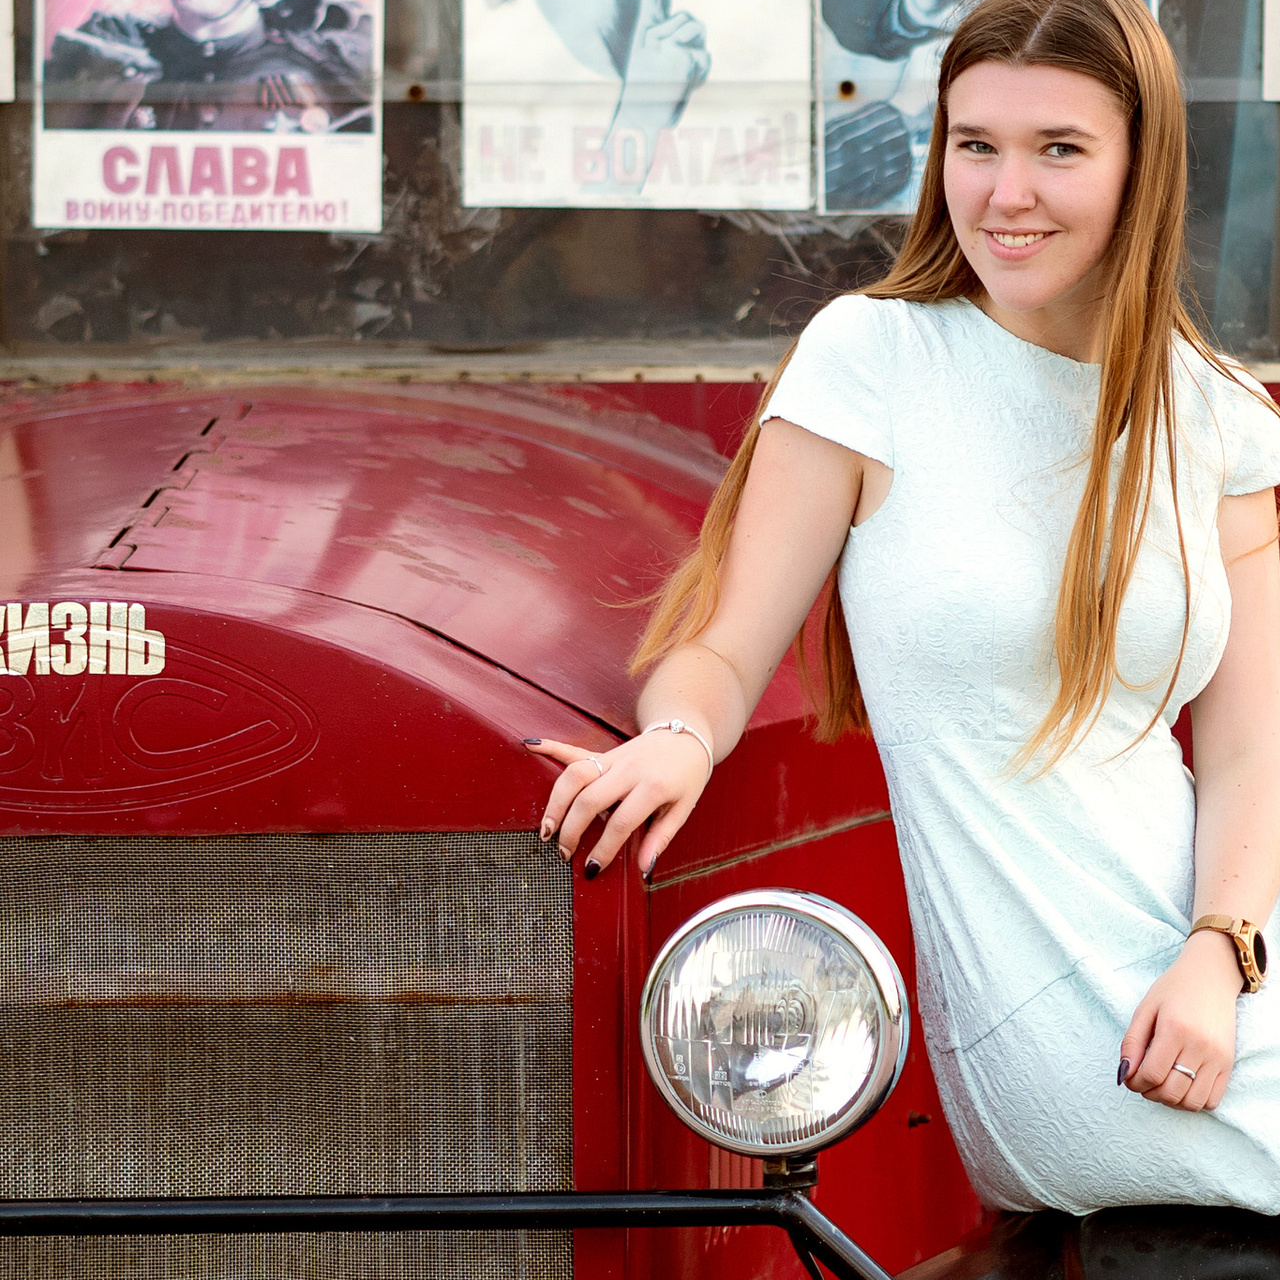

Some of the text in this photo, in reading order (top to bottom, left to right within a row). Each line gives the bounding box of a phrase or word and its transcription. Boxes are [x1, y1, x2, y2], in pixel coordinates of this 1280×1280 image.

[102, 145, 312, 196] СЛАВА
[480, 125, 545, 183] НЕ
[0, 601, 166, 676] ИЗНЬ
[0, 674, 281, 780] ИС
